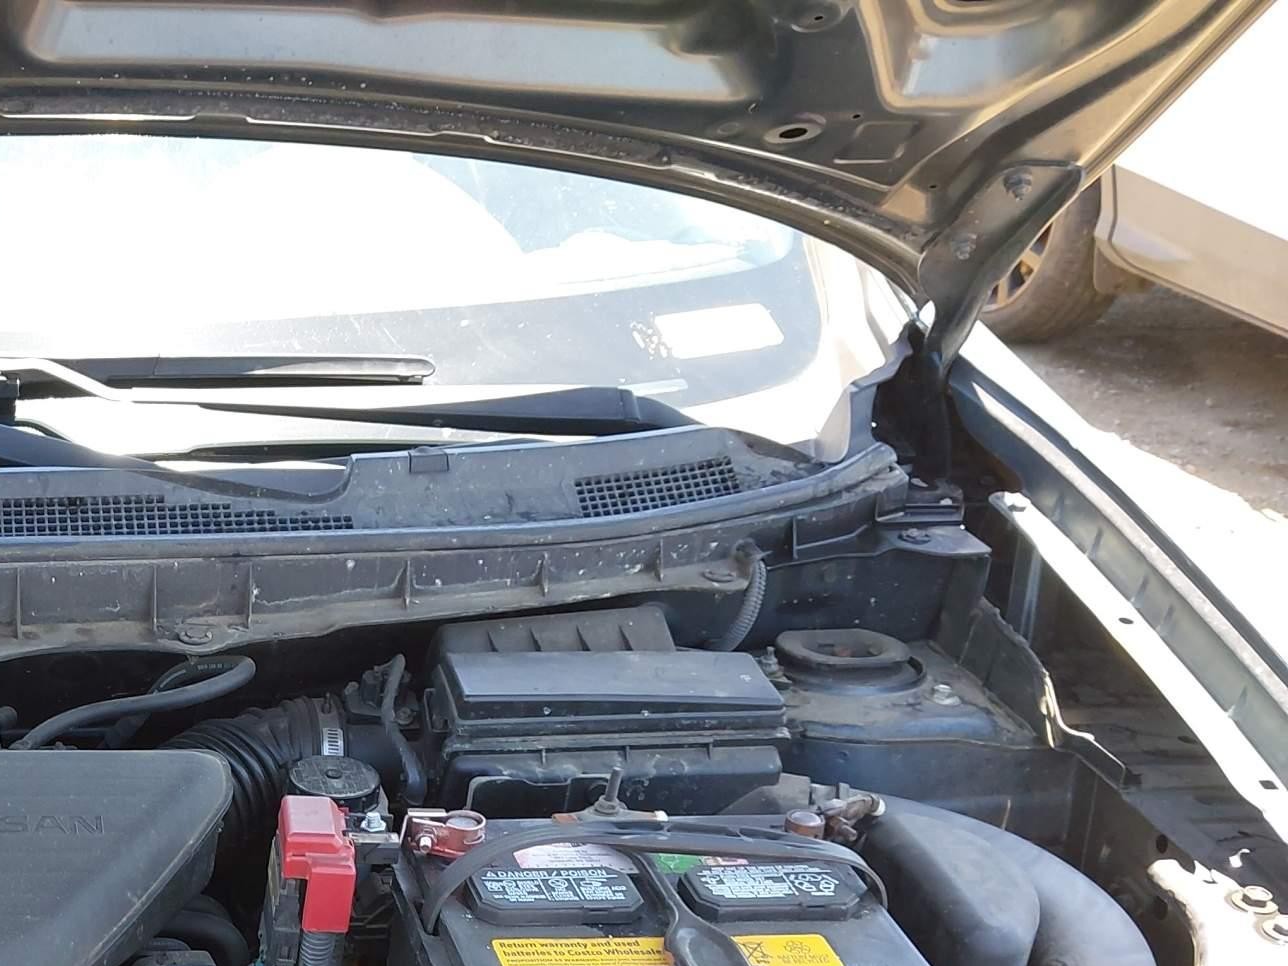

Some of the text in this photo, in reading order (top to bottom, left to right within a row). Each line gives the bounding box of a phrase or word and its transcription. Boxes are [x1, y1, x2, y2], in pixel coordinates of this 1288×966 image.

[561, 869, 608, 877] POISON
[540, 941, 588, 949] warranty
[590, 940, 612, 948] and
[503, 949, 553, 957] batteries
[553, 949, 565, 957] to
